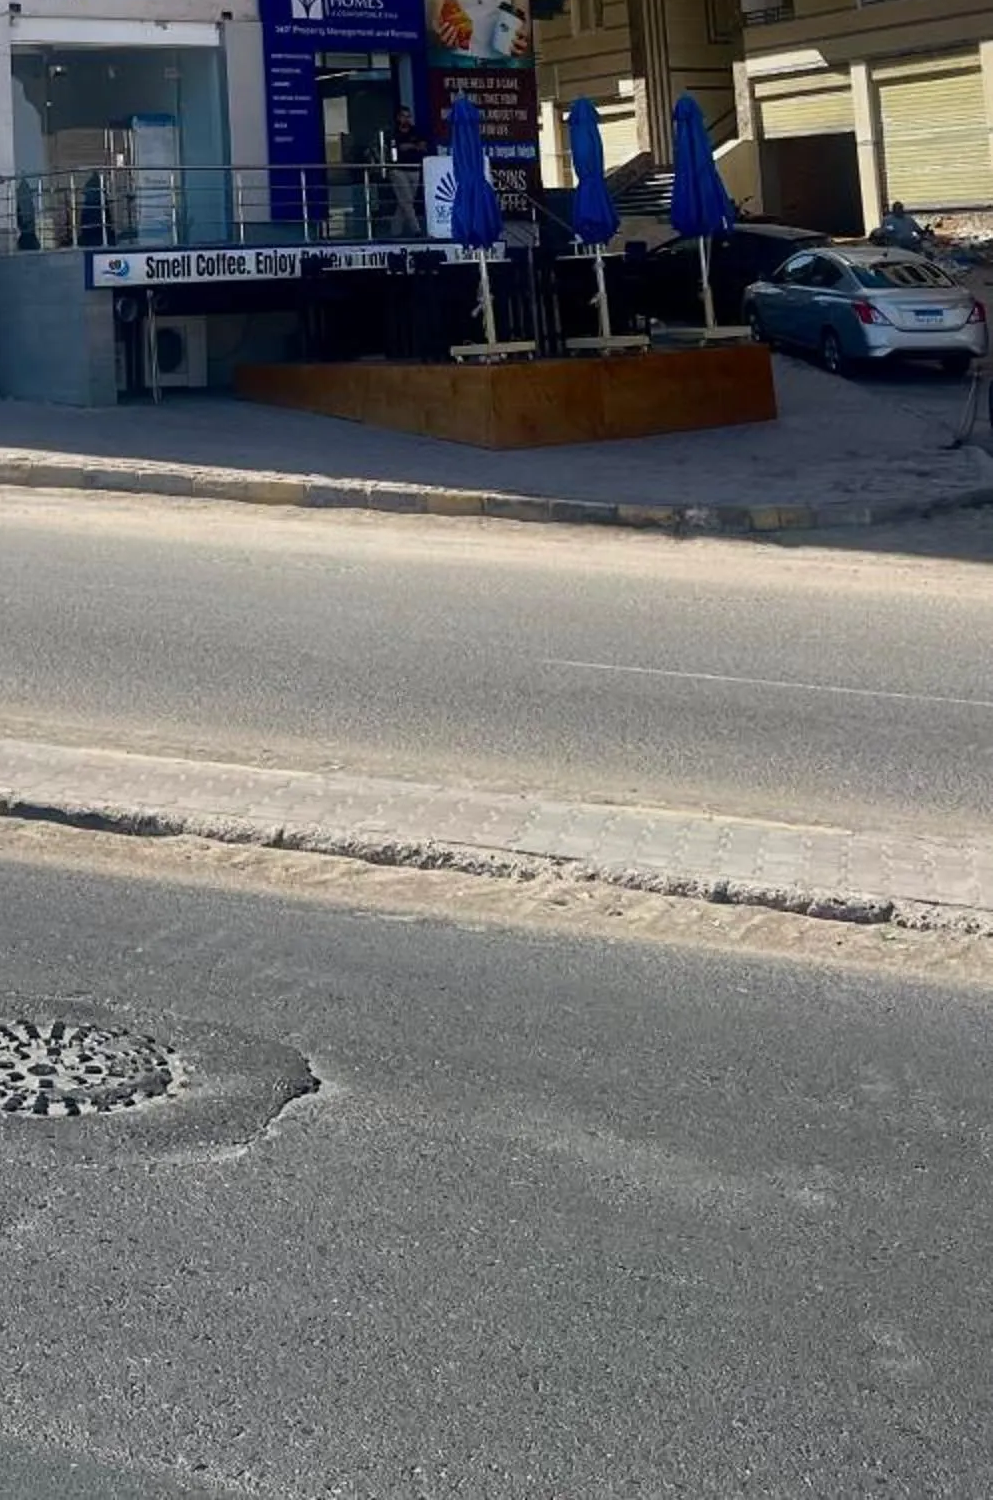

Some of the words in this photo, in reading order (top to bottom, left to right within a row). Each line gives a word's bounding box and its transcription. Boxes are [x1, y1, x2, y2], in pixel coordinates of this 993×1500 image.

[145, 254, 192, 280] Smell
[195, 251, 251, 277] Coffee.
[255, 248, 297, 278] Enjoy
